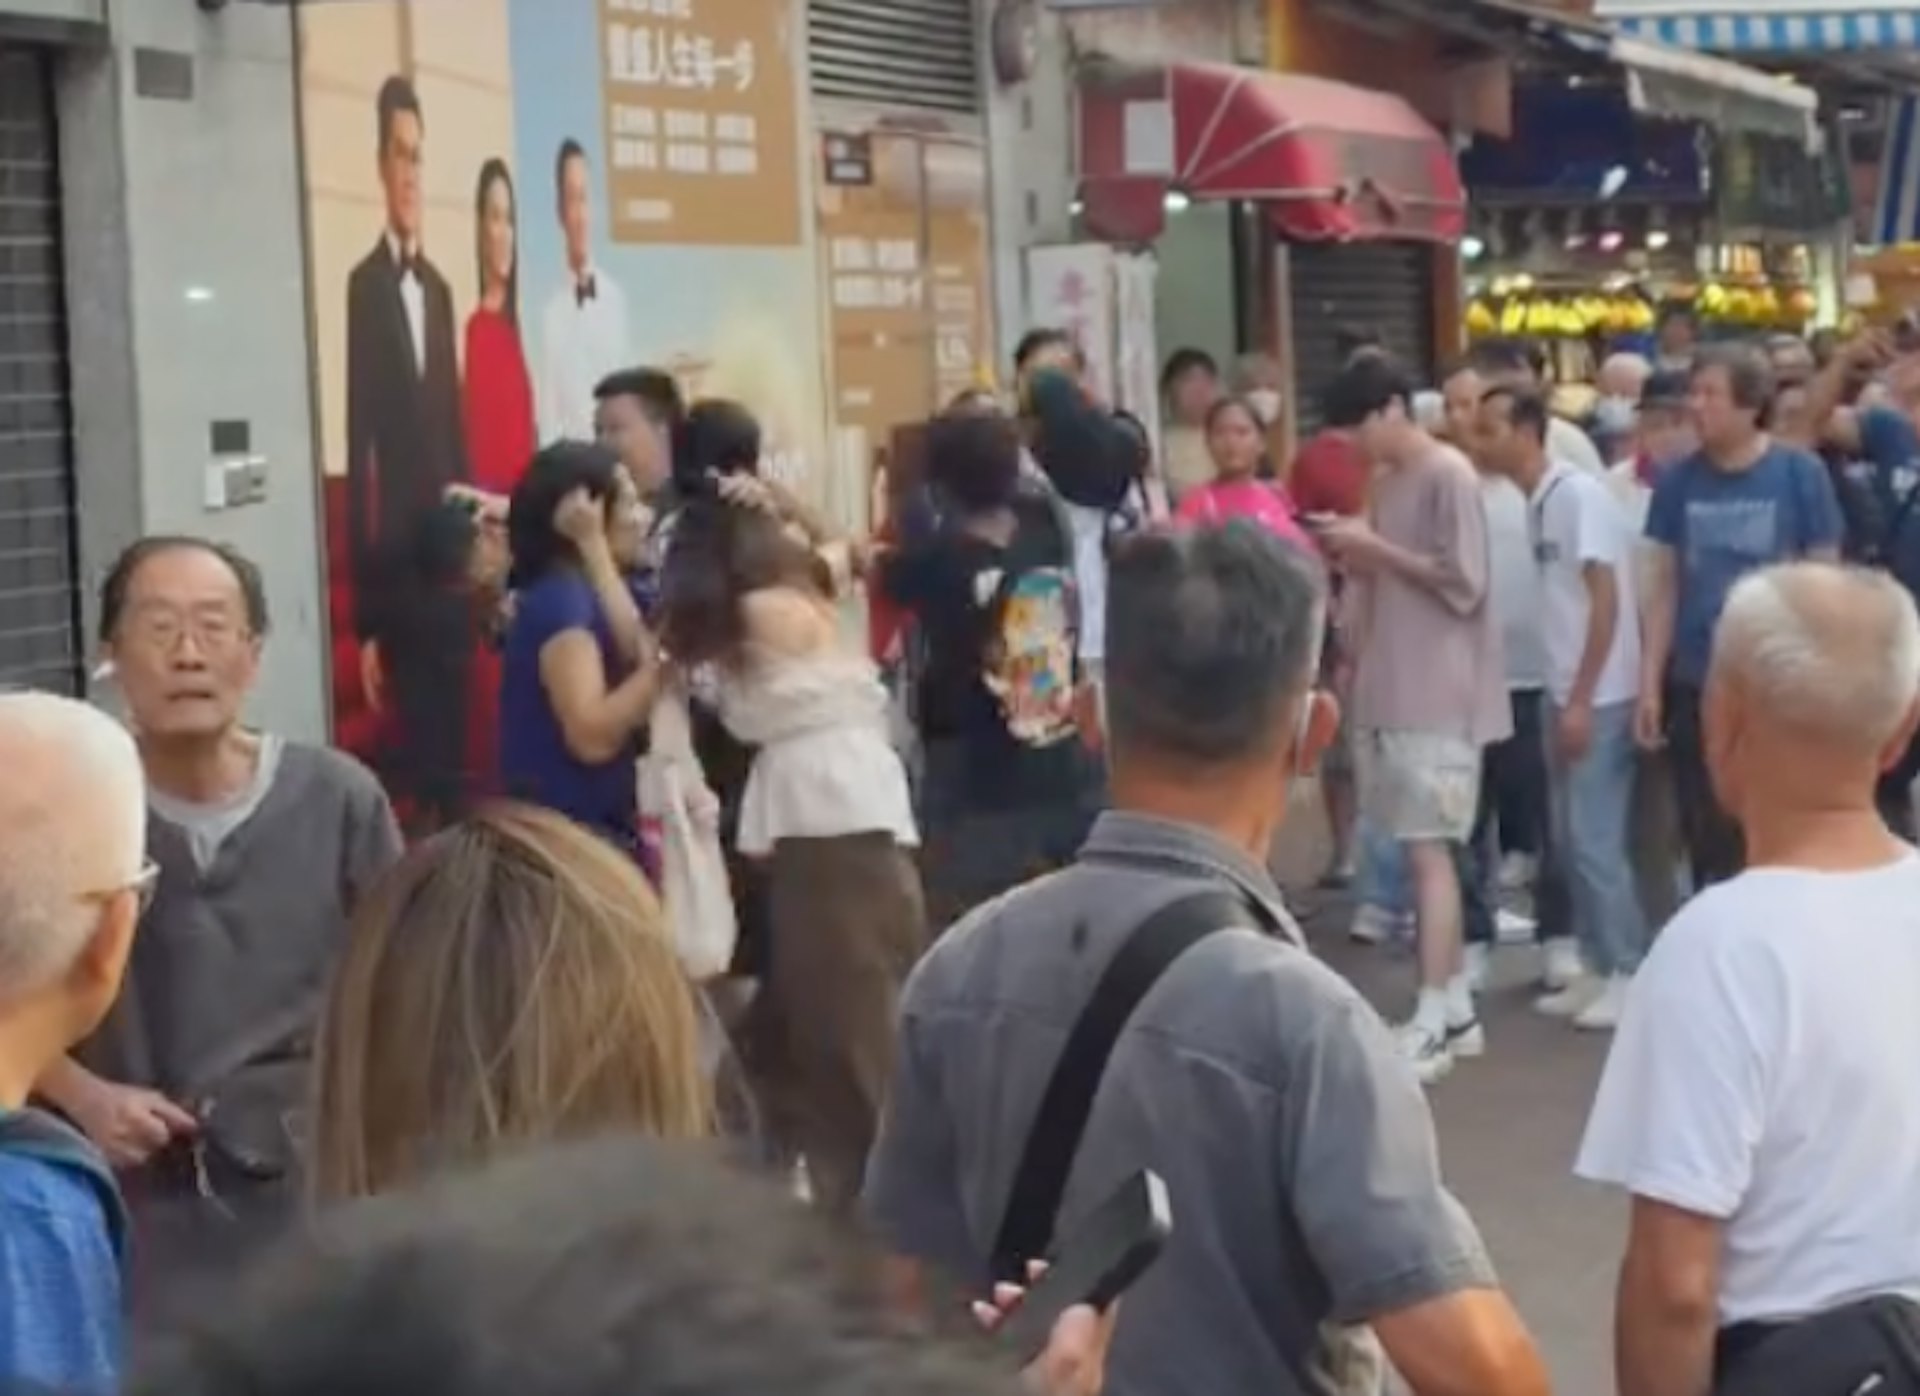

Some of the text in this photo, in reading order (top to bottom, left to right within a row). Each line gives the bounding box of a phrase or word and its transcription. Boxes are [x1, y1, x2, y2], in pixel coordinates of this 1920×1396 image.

[608, 23, 754, 92] 人生每一步
